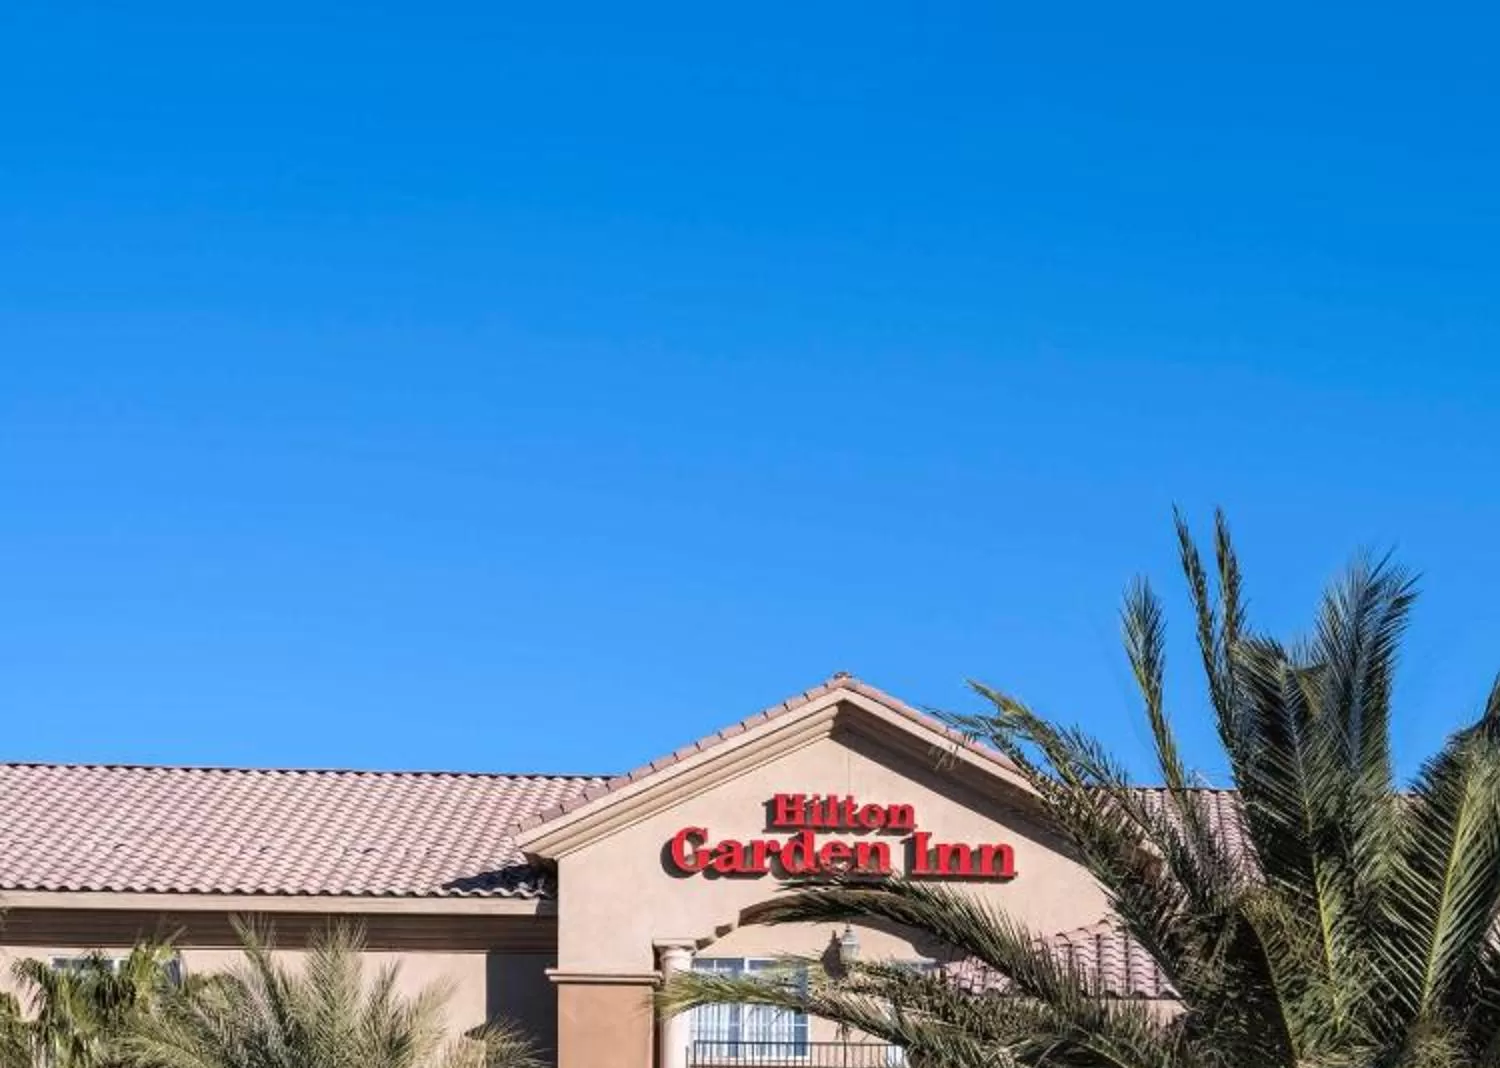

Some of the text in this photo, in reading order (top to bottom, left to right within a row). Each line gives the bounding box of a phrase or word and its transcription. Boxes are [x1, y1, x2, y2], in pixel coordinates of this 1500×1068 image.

[772, 793, 917, 829] Hilton
[671, 827, 1018, 877] Garden Inn
